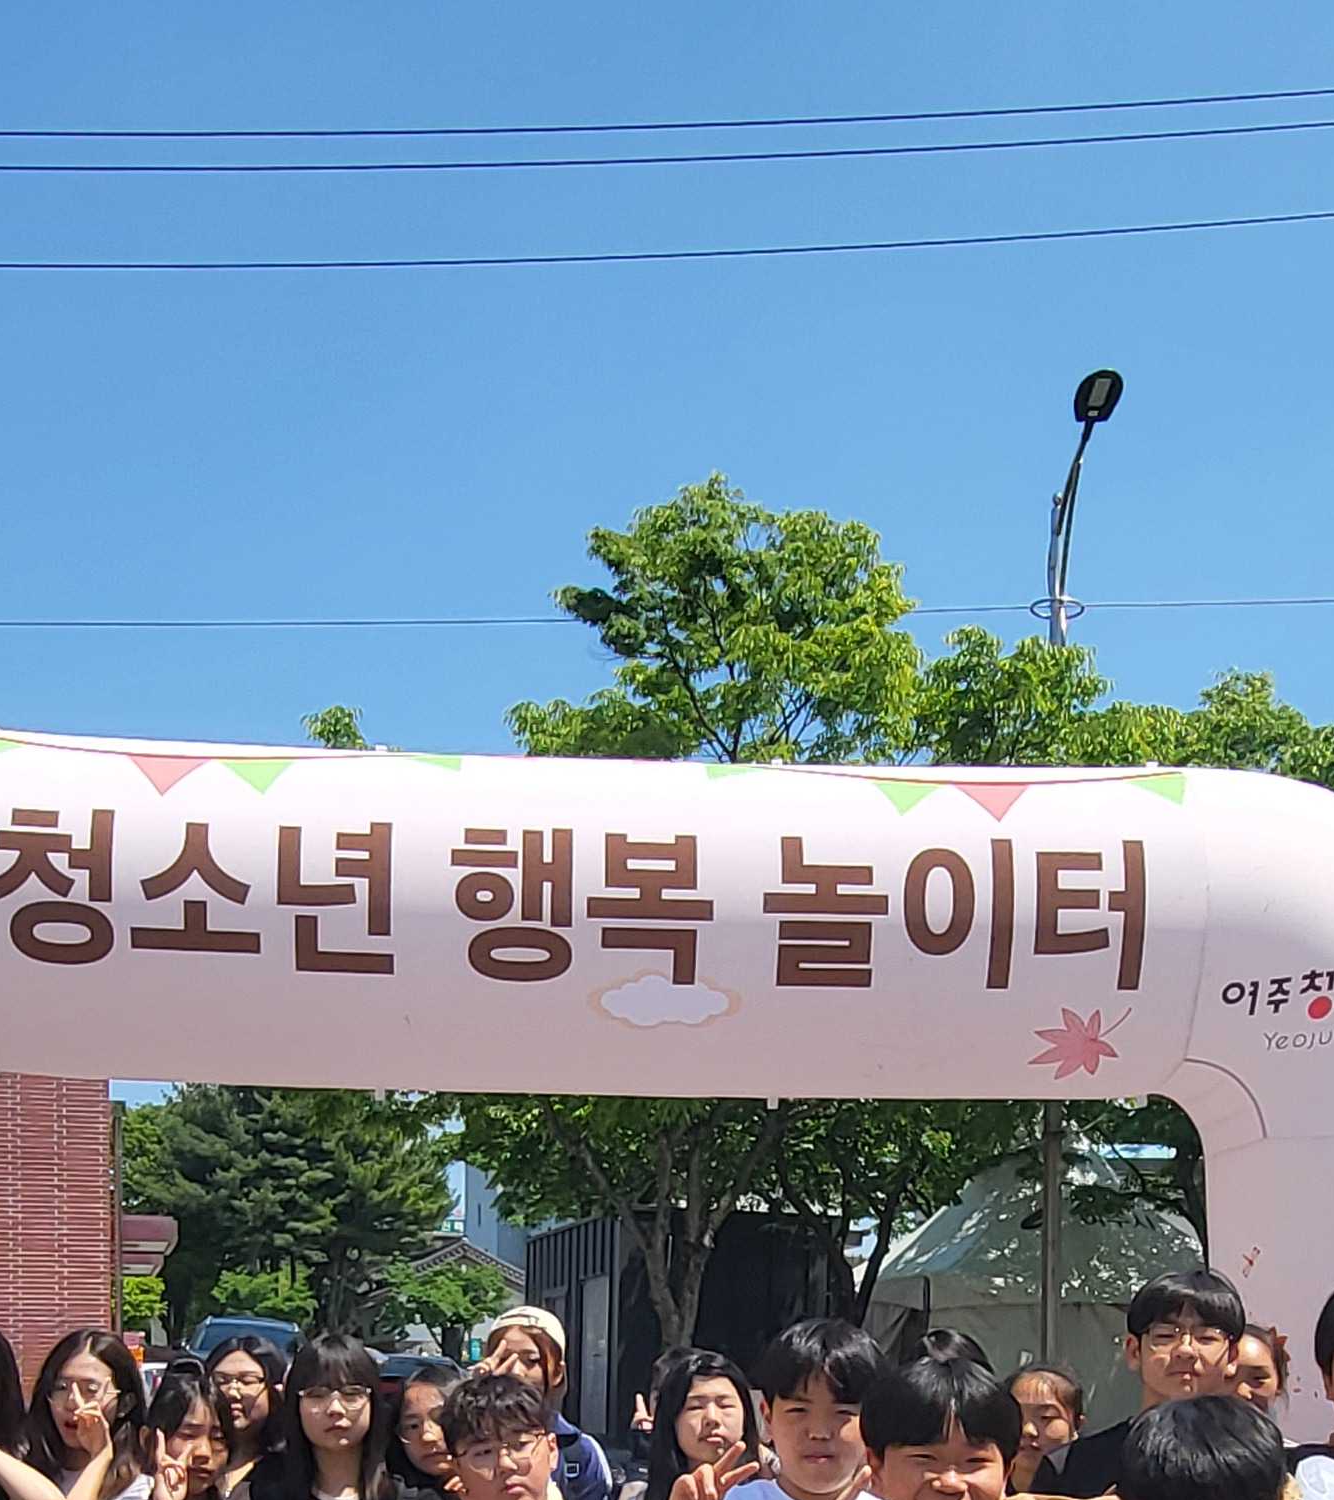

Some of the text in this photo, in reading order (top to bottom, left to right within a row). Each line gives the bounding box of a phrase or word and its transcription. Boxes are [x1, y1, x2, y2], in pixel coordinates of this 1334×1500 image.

[450, 826, 716, 985] 행복
[762, 835, 1146, 992] 놀이터
[1262, 1029, 1334, 1052] Yeoju
